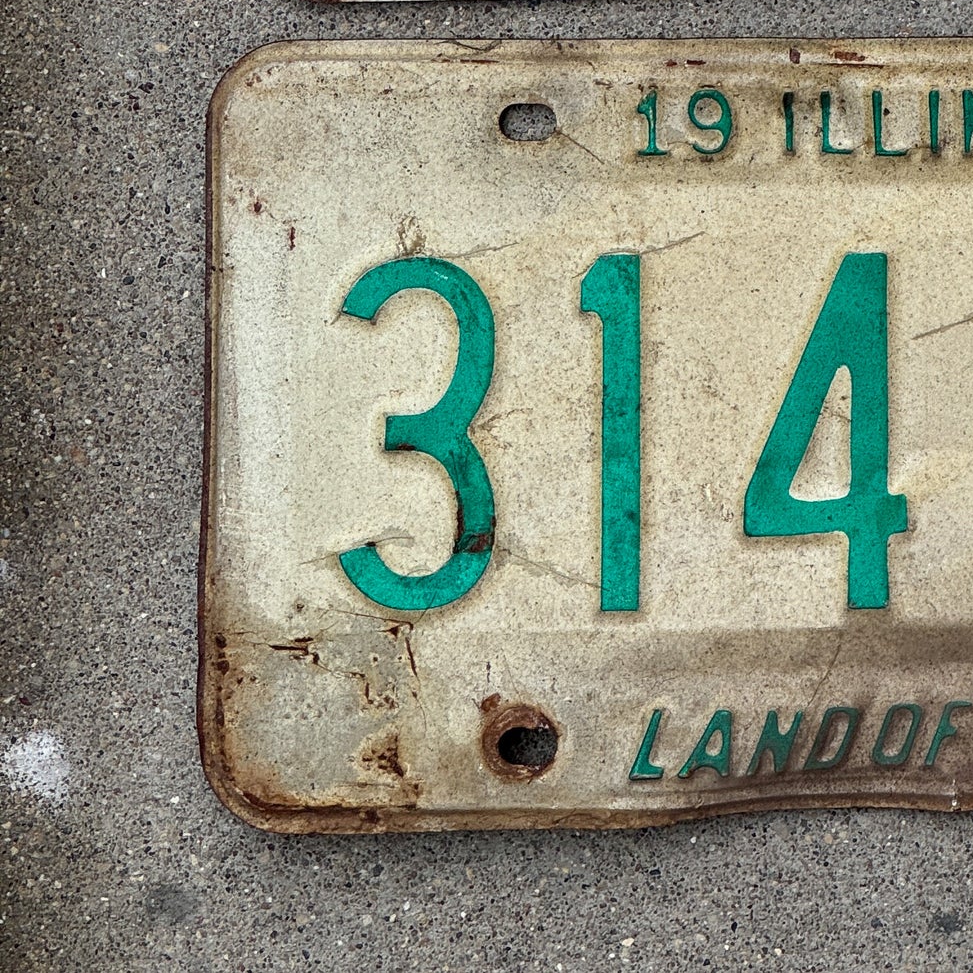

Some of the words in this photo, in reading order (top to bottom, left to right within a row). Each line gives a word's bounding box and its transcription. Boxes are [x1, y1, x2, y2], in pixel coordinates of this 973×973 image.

[636, 88, 734, 157] 19
[338, 252, 909, 612] 314
[628, 706, 861, 781] LAND
[871, 700, 973, 767] OF
